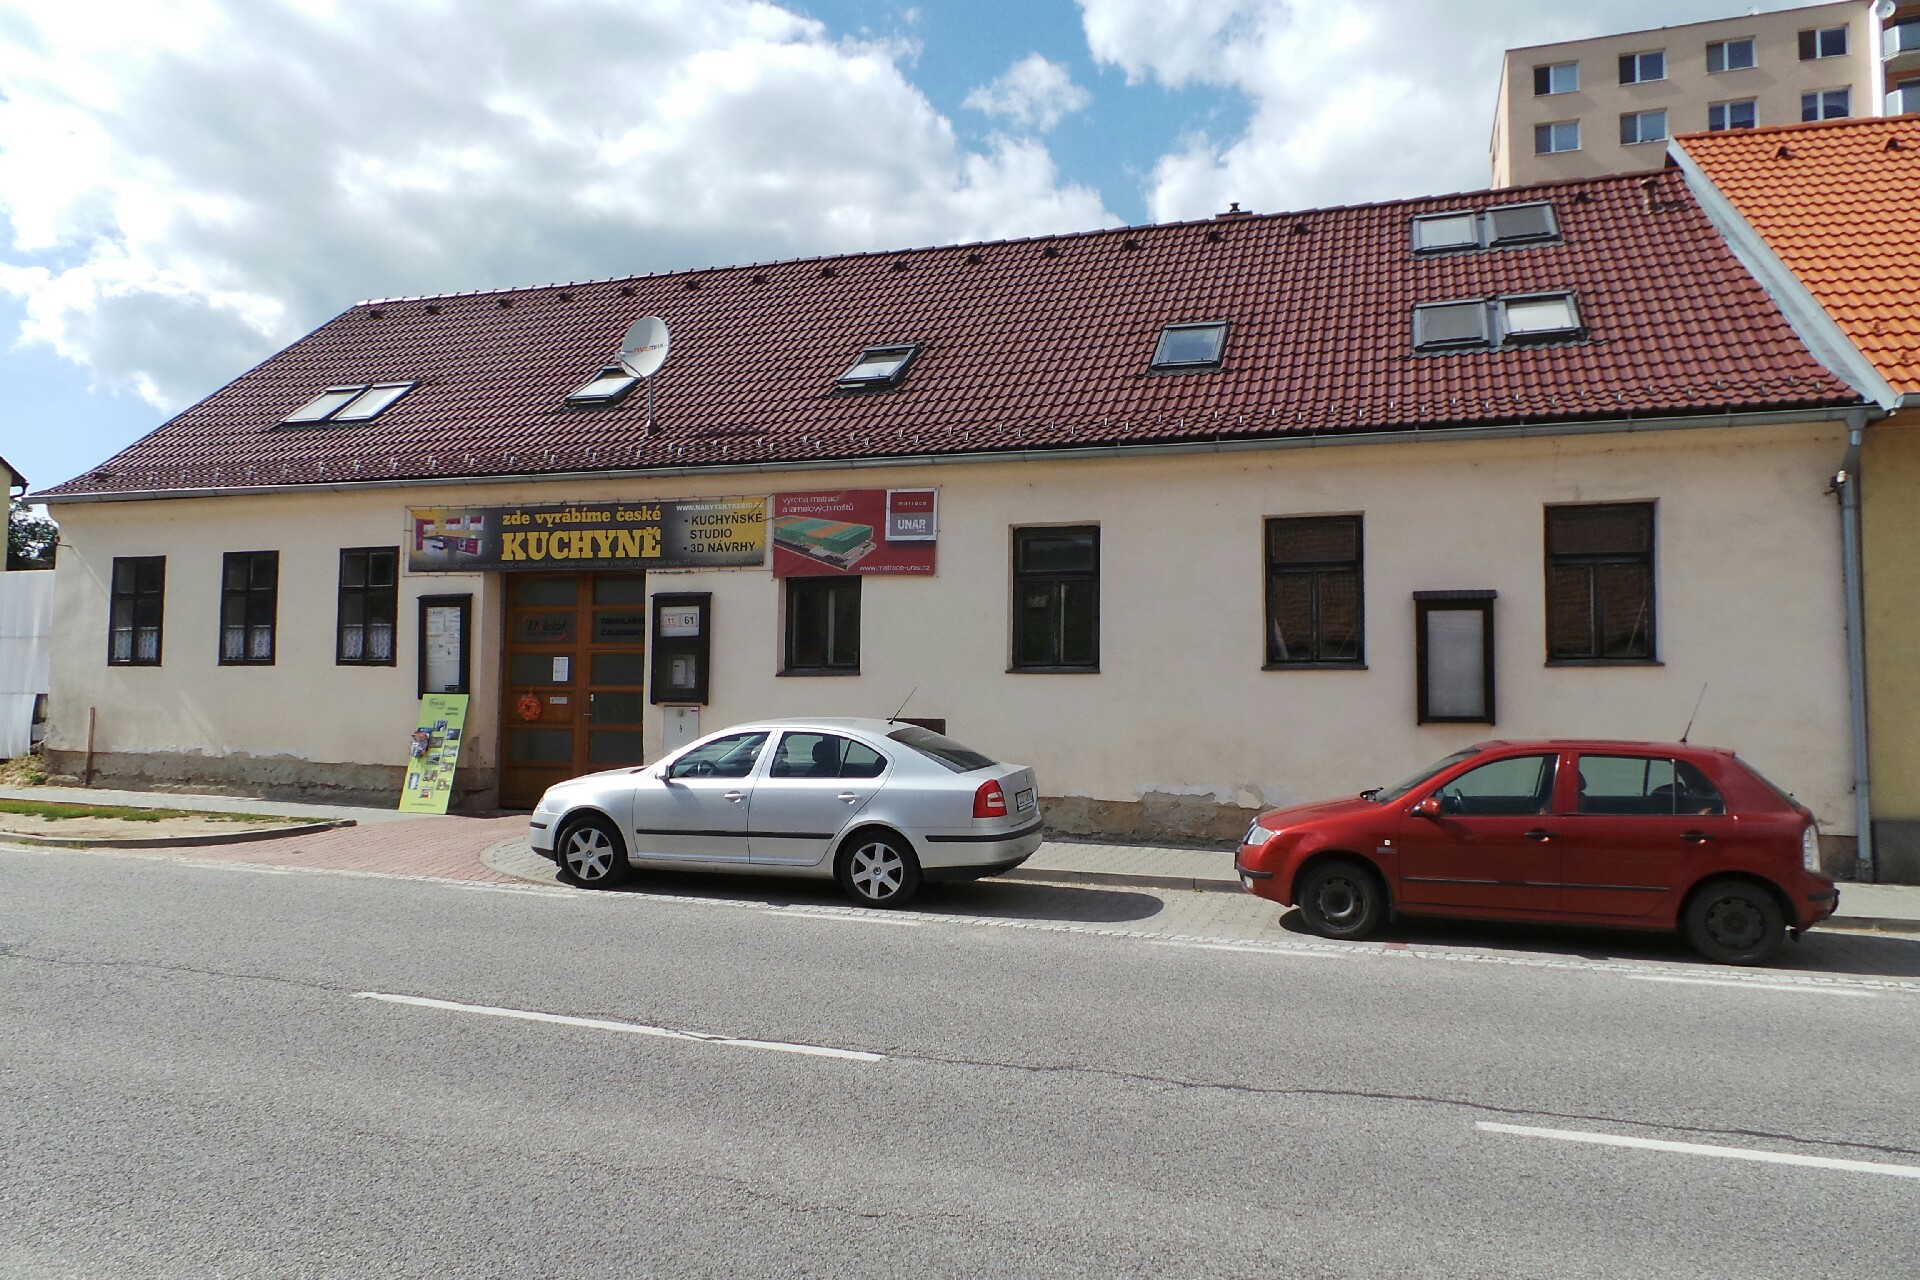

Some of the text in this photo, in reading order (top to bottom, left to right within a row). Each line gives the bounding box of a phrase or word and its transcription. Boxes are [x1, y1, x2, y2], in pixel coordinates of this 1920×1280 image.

[788, 505, 832, 513] lamelových
[502, 505, 662, 527] zde vyrábíme české
[691, 511, 763, 526] KUCHYŇSKÉ
[897, 519, 926, 529] UNAR
[689, 528, 733, 540] STUDIO
[501, 527, 661, 561] KUCHYNĚ
[690, 540, 756, 553] 3D NÁVRHY
[684, 616, 695, 625] 61
